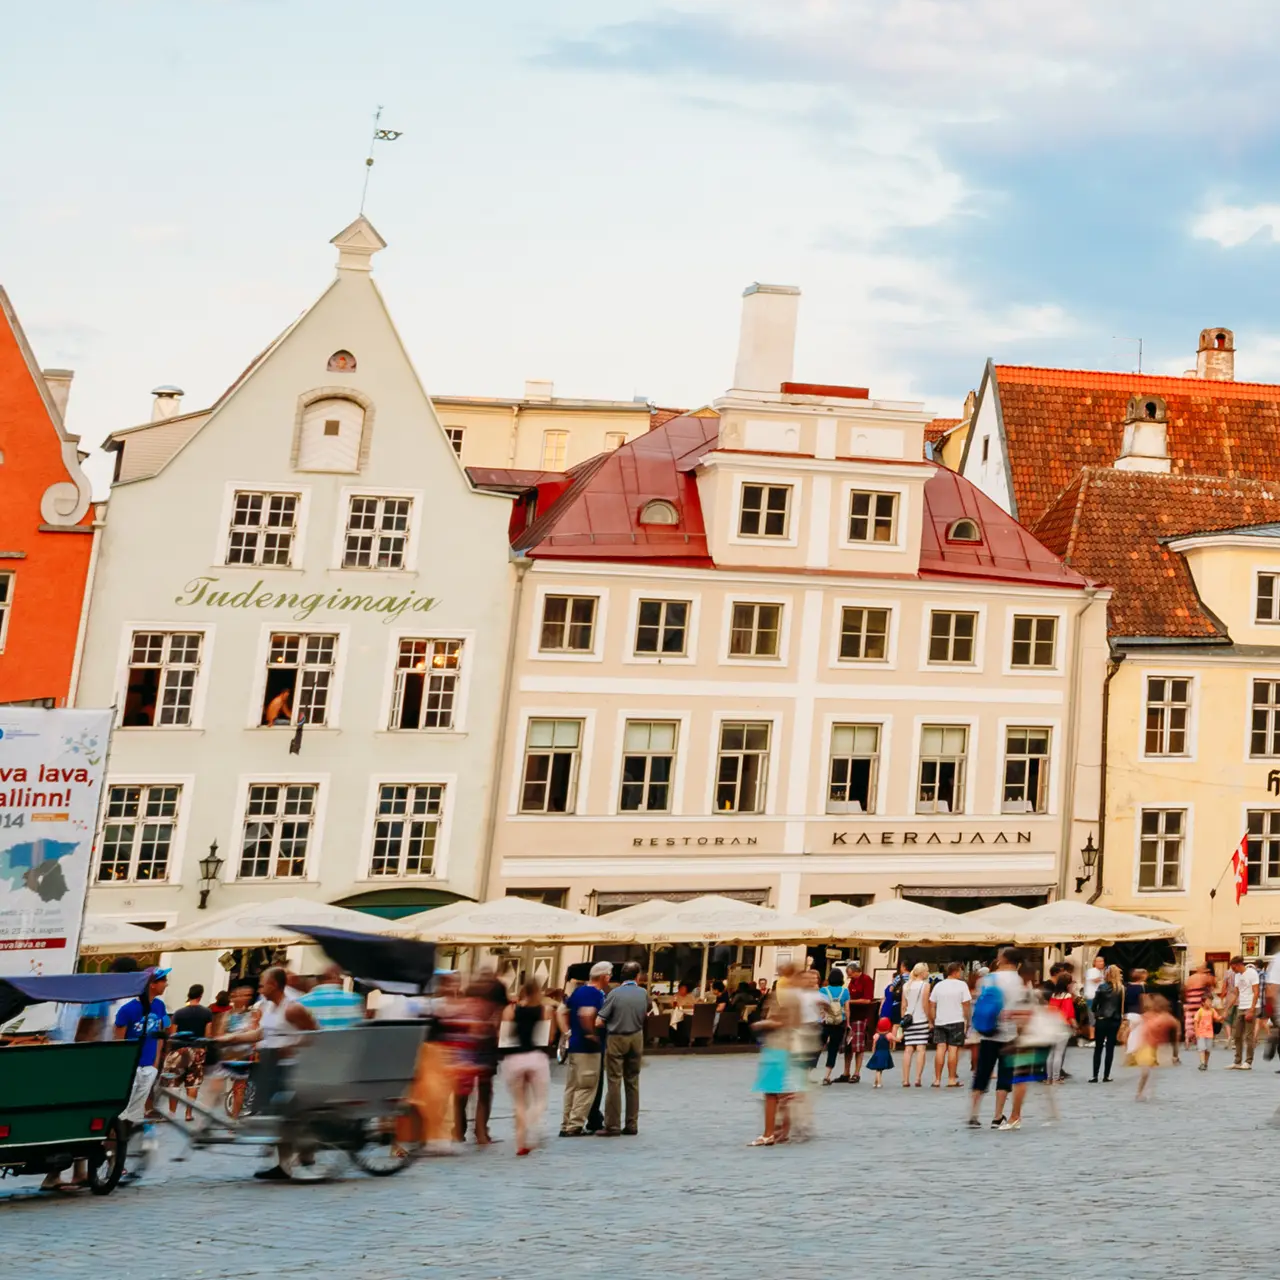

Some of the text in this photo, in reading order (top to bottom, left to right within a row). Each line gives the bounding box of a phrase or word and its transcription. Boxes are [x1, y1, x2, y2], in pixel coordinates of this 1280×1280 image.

[175, 577, 442, 624] Tudengimaja
[38, 764, 93, 787] lava,
[0, 813, 24, 828] 14
[633, 831, 1032, 846] RESTORAN KAERAJAAN
